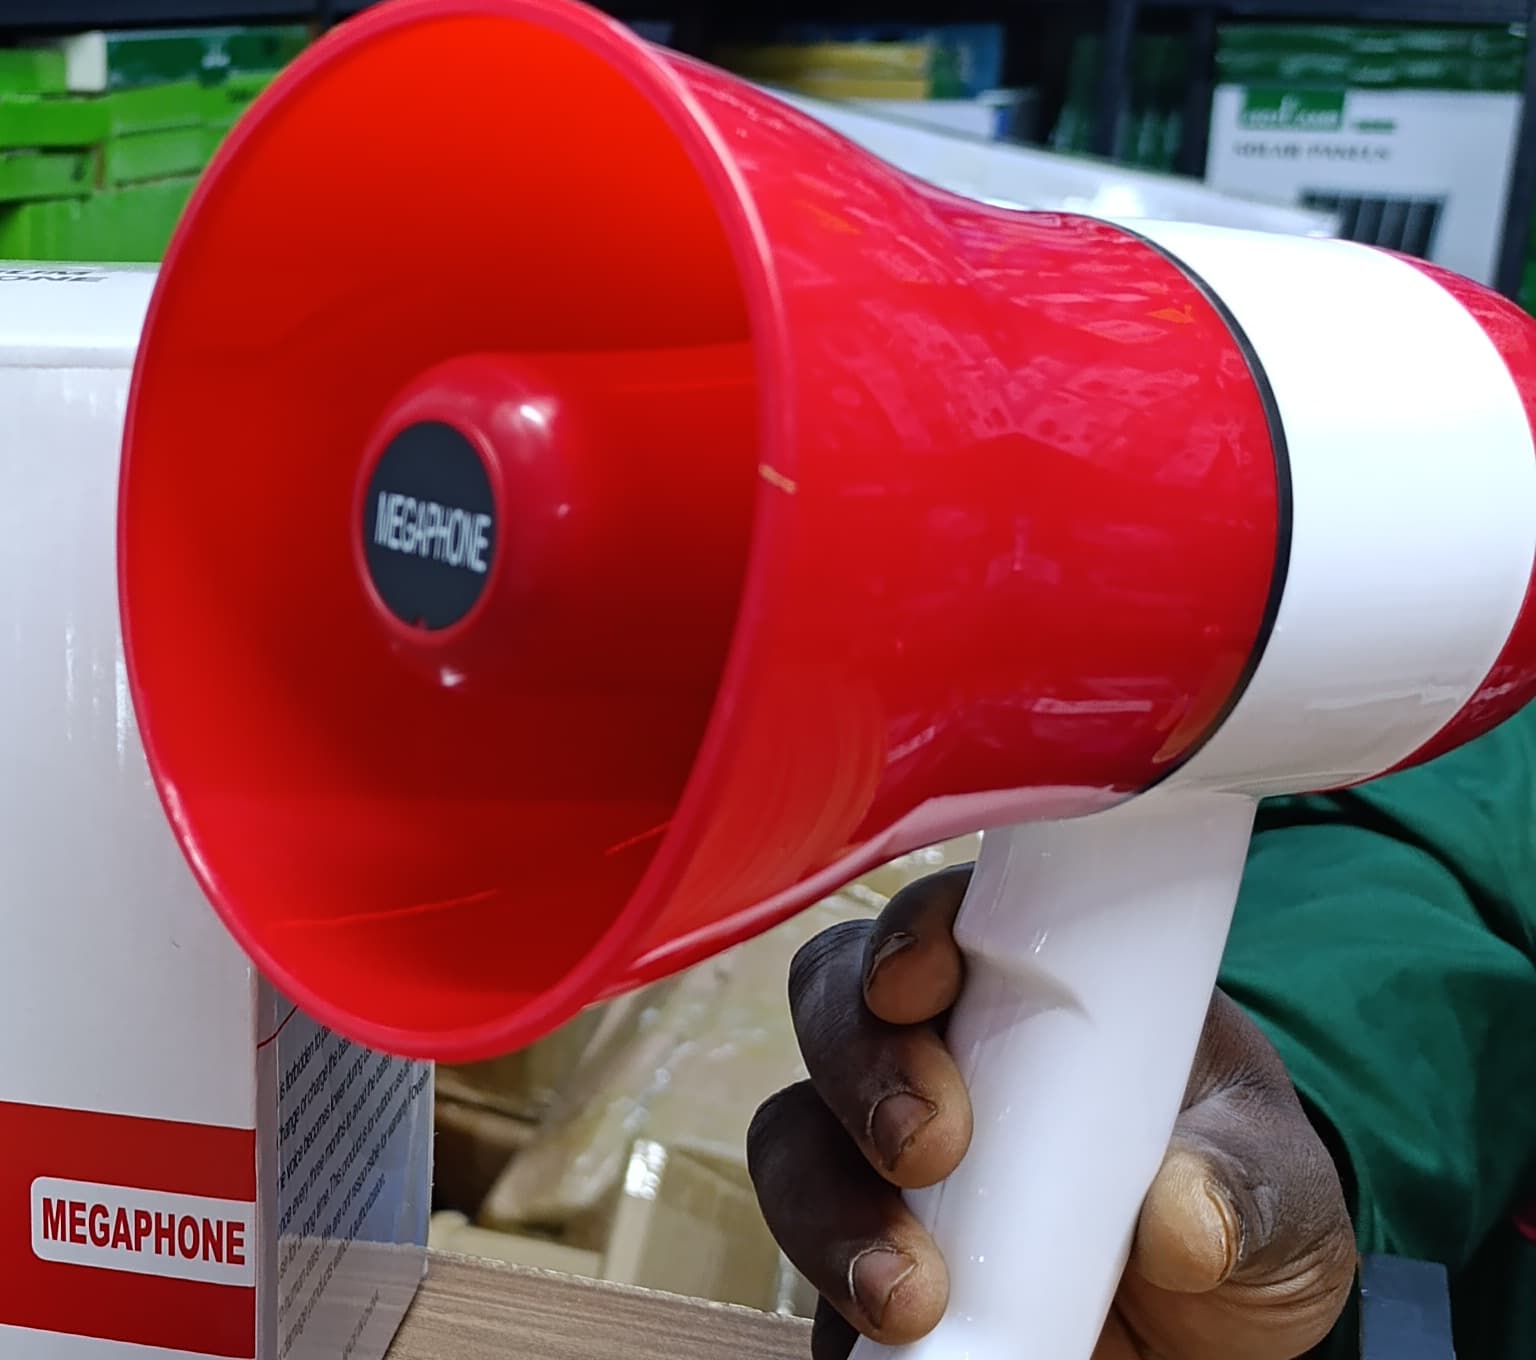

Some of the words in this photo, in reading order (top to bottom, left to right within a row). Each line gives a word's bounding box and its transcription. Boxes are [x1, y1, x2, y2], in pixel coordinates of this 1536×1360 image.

[374, 491, 492, 573] MEGAPHONE
[286, 1035, 313, 1094] forbidden
[308, 1058, 327, 1111] charge
[286, 1137, 302, 1183] voice
[303, 1097, 329, 1157] becomes
[330, 1073, 345, 1115] lower
[346, 1047, 362, 1096] during
[292, 1175, 308, 1223] every
[309, 1147, 324, 1192] three
[325, 1116, 345, 1167] months
[352, 1080, 366, 1124] avoid
[342, 1131, 362, 1185] product
[351, 1135, 380, 1204] responsible
[41, 1195, 247, 1267] MEGAPHONE
